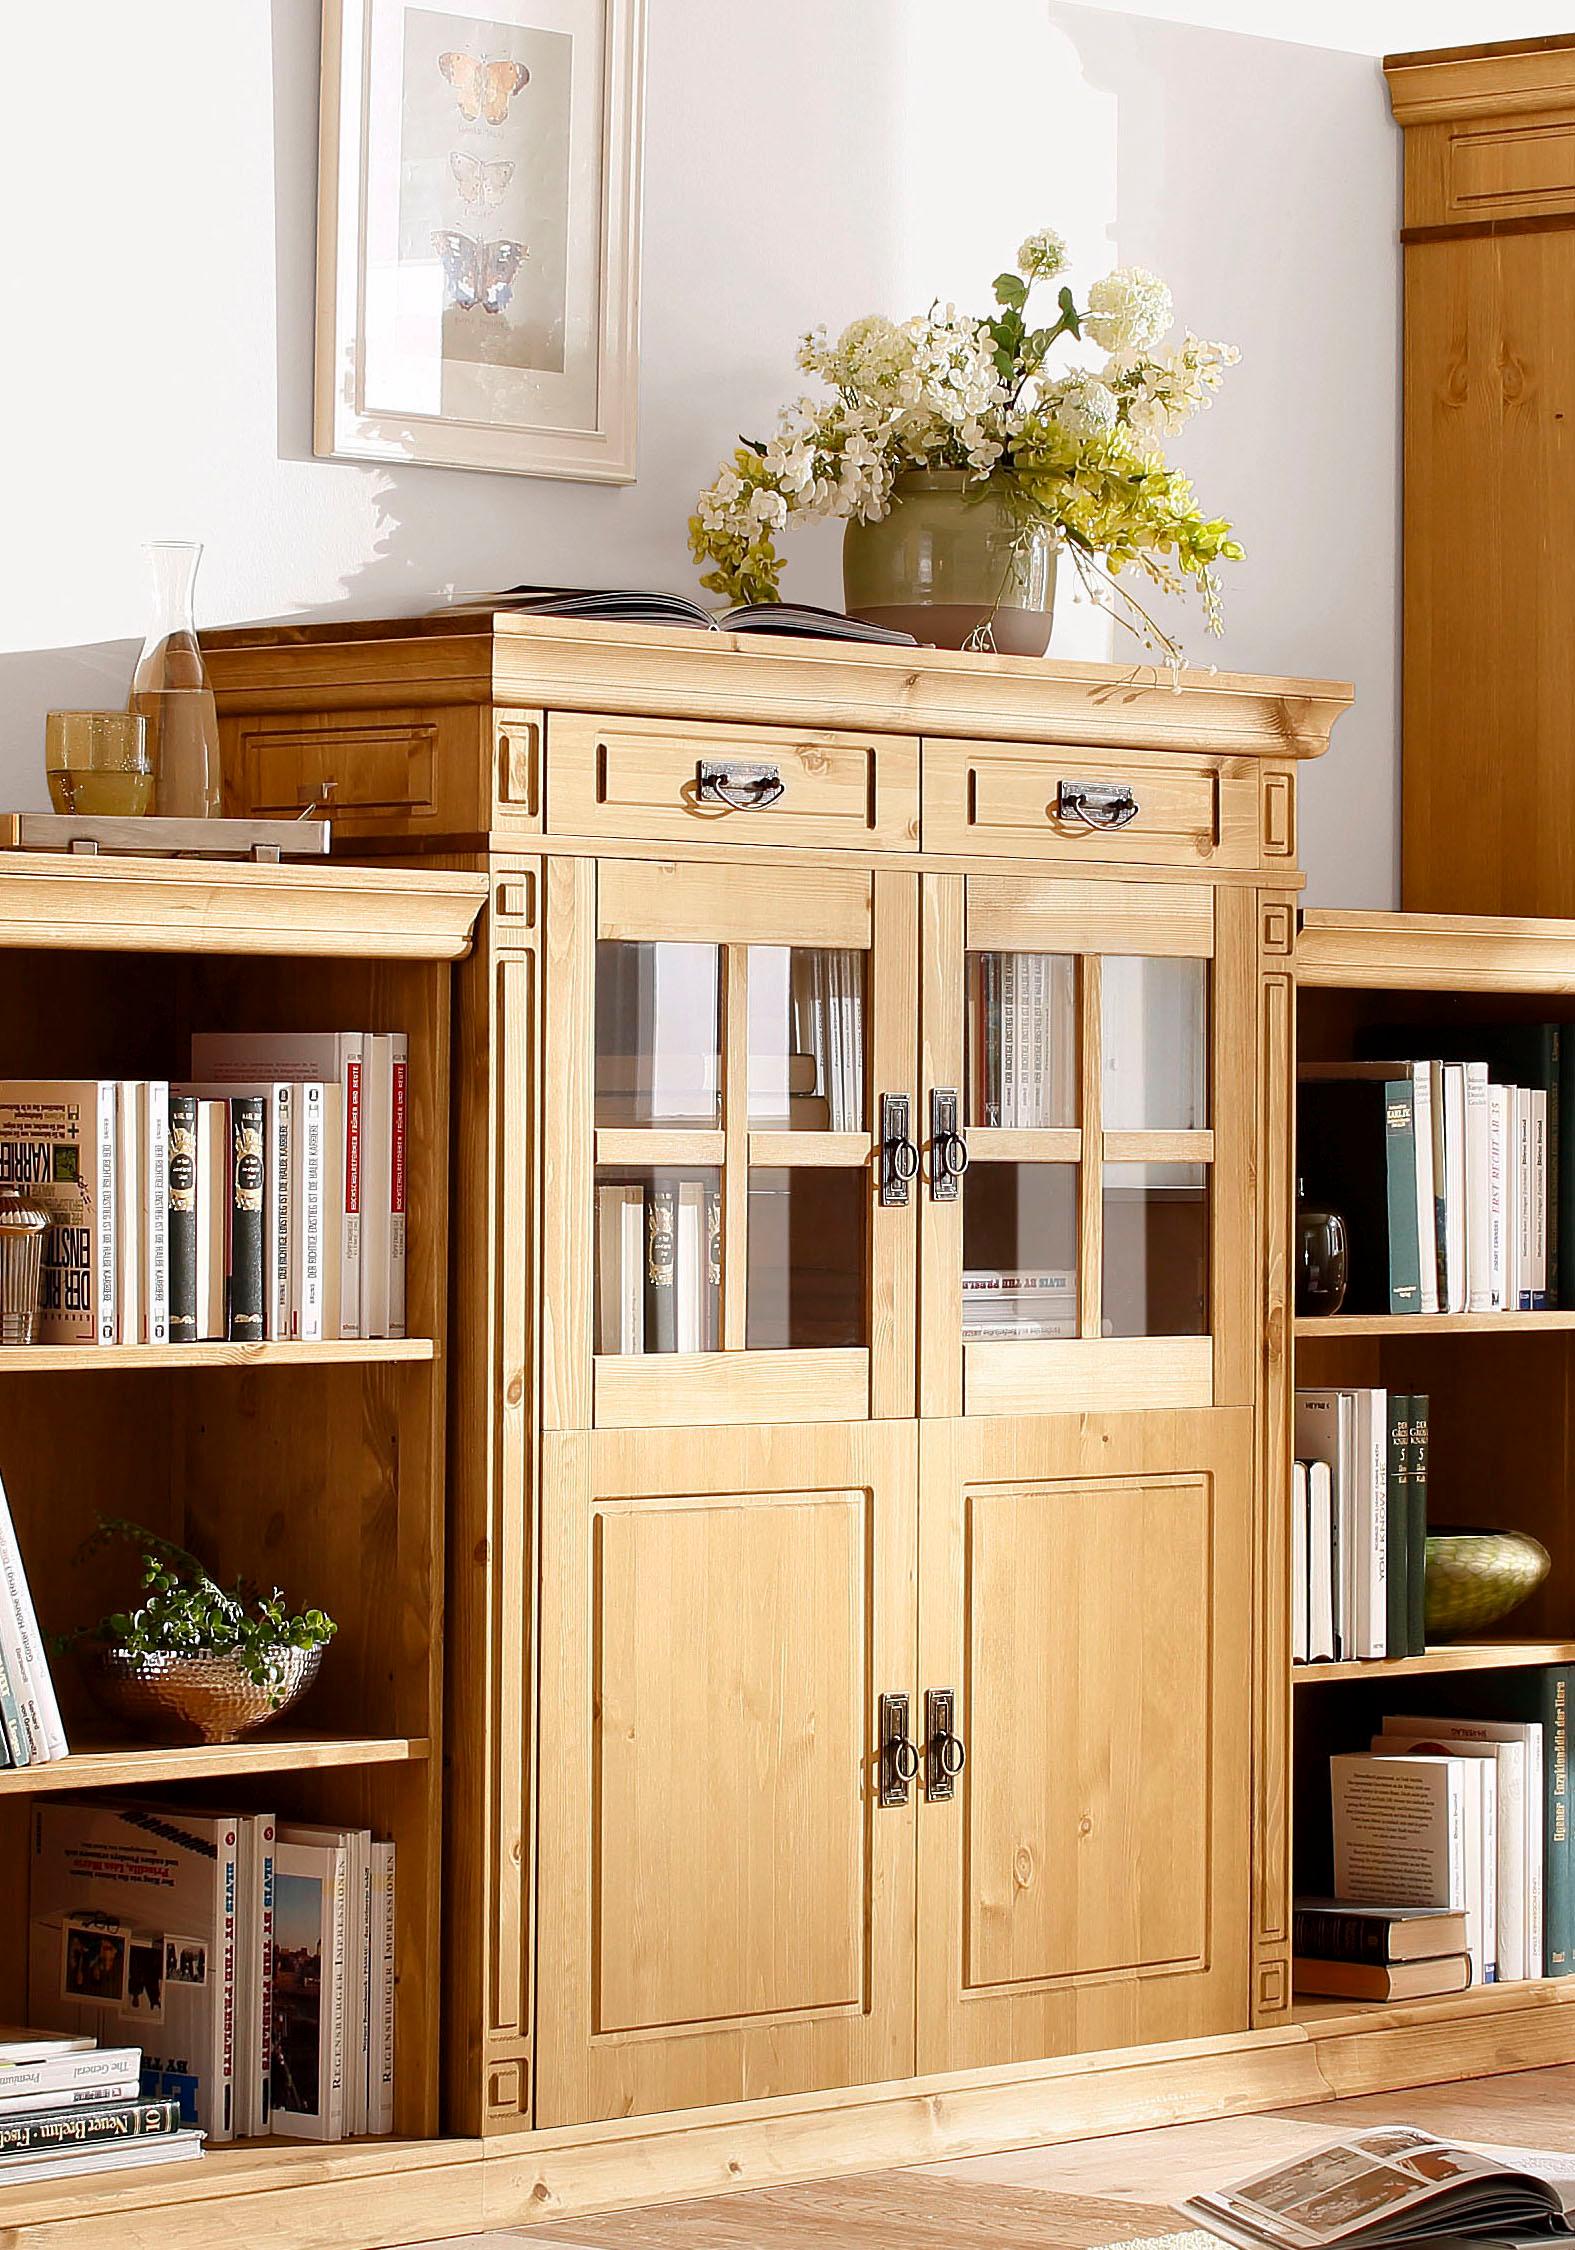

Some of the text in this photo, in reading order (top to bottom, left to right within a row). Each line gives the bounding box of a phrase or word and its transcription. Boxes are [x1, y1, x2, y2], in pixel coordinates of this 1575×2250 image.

[64, 1270, 91, 1311] DER
[13, 1598, 27, 1629] Höhne
[20, 1631, 34, 1663] Günter
[223, 1861, 234, 2077] ELVIS BY THE PRESLEYS
[261, 1857, 273, 2071] ELVIS BY THE PRESLEYS
[383, 1855, 394, 2083] REGENSBURGER IMPRESSIONEN
[73, 2060, 130, 2079] The General
[40, 2113, 130, 2143] Neuer Brehm
